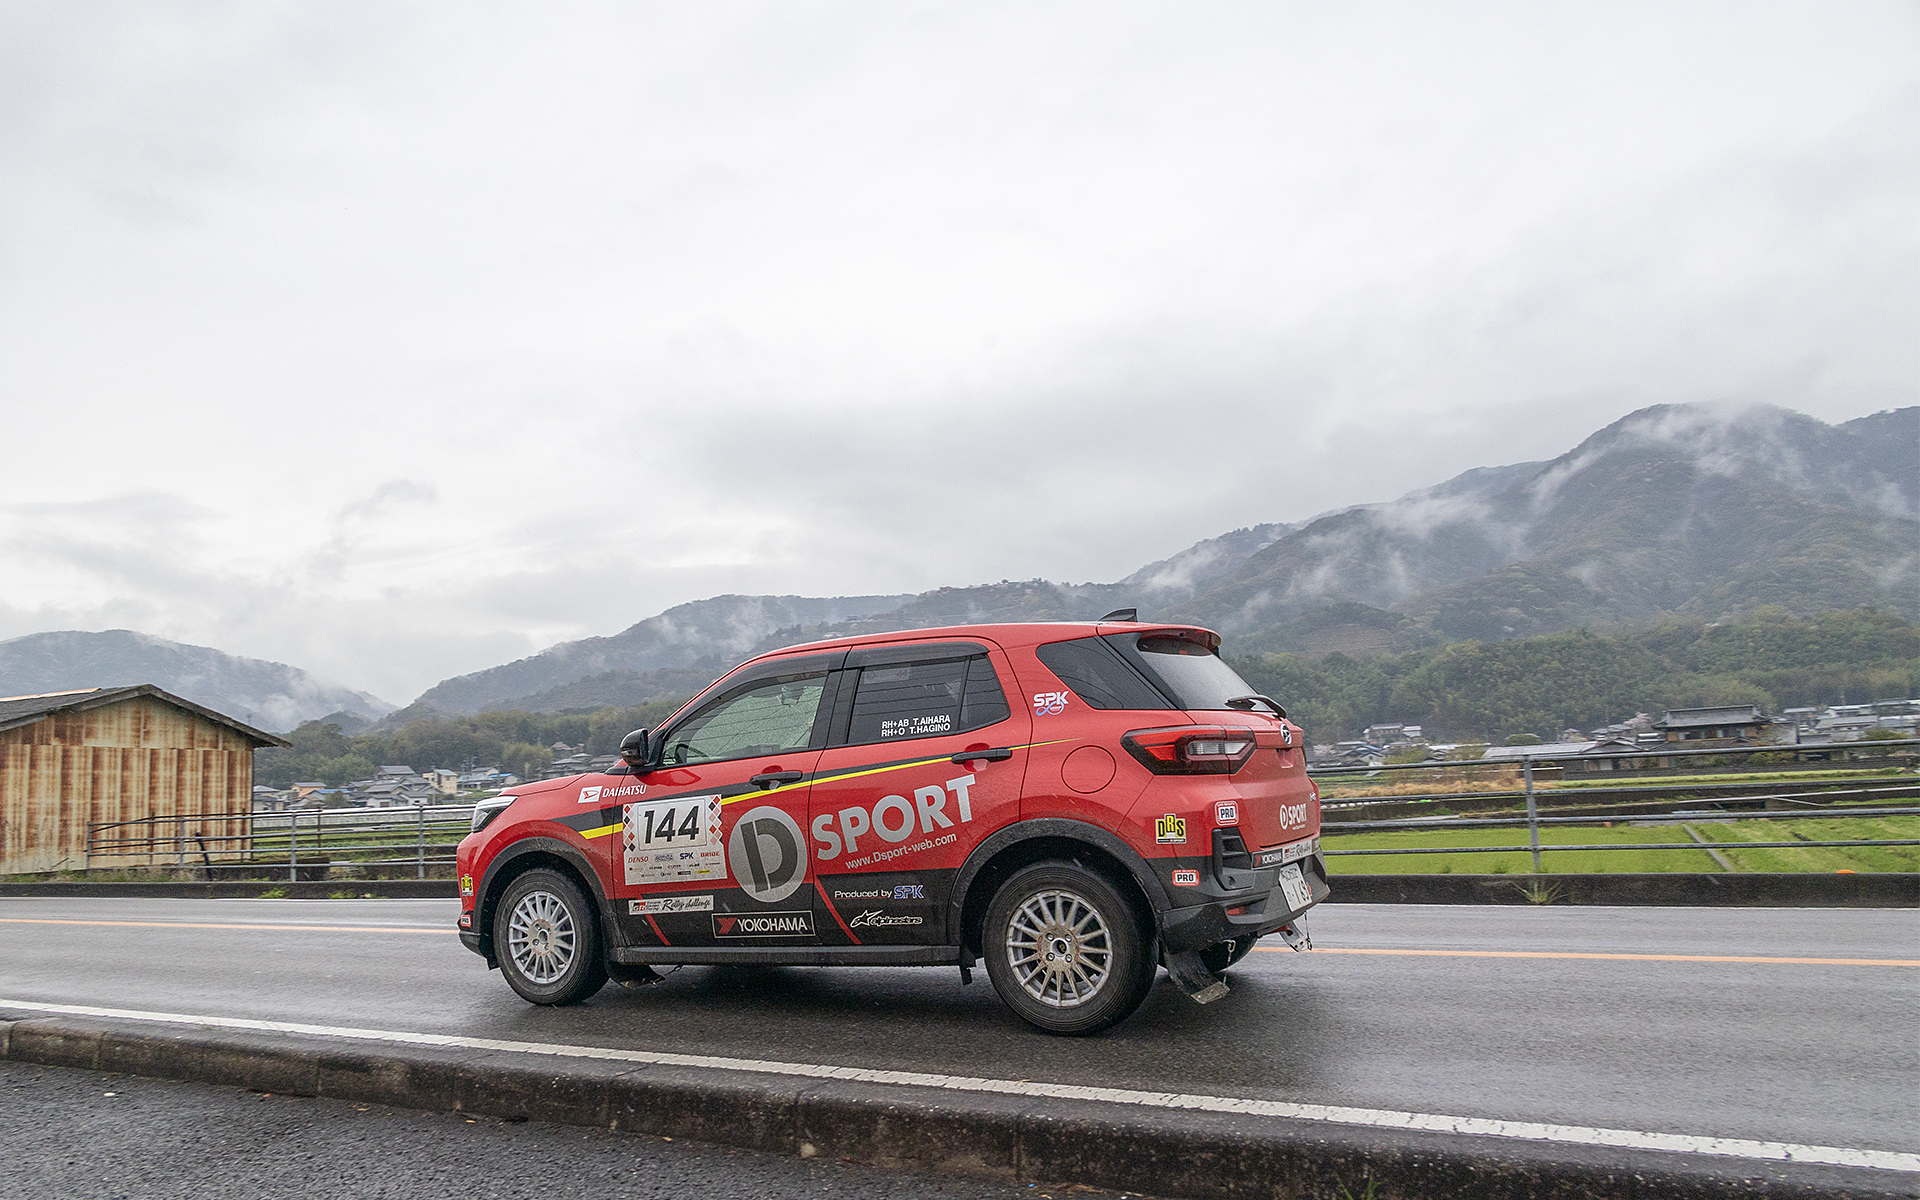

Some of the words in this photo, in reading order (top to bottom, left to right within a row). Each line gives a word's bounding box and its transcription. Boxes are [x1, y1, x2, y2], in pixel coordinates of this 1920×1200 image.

[1033, 691, 1069, 707] SPK
[881, 719, 909, 729] RH+AB
[913, 715, 950, 726] T.AIHARA
[881, 728, 905, 737] RH+O
[909, 723, 950, 734] T.HAGINO
[602, 784, 647, 798] DAIHATSU
[812, 774, 976, 860] SPORT
[1220, 807, 1234, 818] PRO
[1288, 803, 1307, 825] SPORT
[643, 805, 699, 844] 144
[1158, 814, 1184, 837] DRS
[680, 852, 694, 860] SPK
[845, 833, 957, 870] www.Dsport-web.com
[1177, 874, 1194, 882] PRO
[834, 890, 878, 899] Produced
[881, 889, 892, 898] by
[894, 884, 924, 899] SPK
[737, 917, 808, 932] YOKOHAMA
